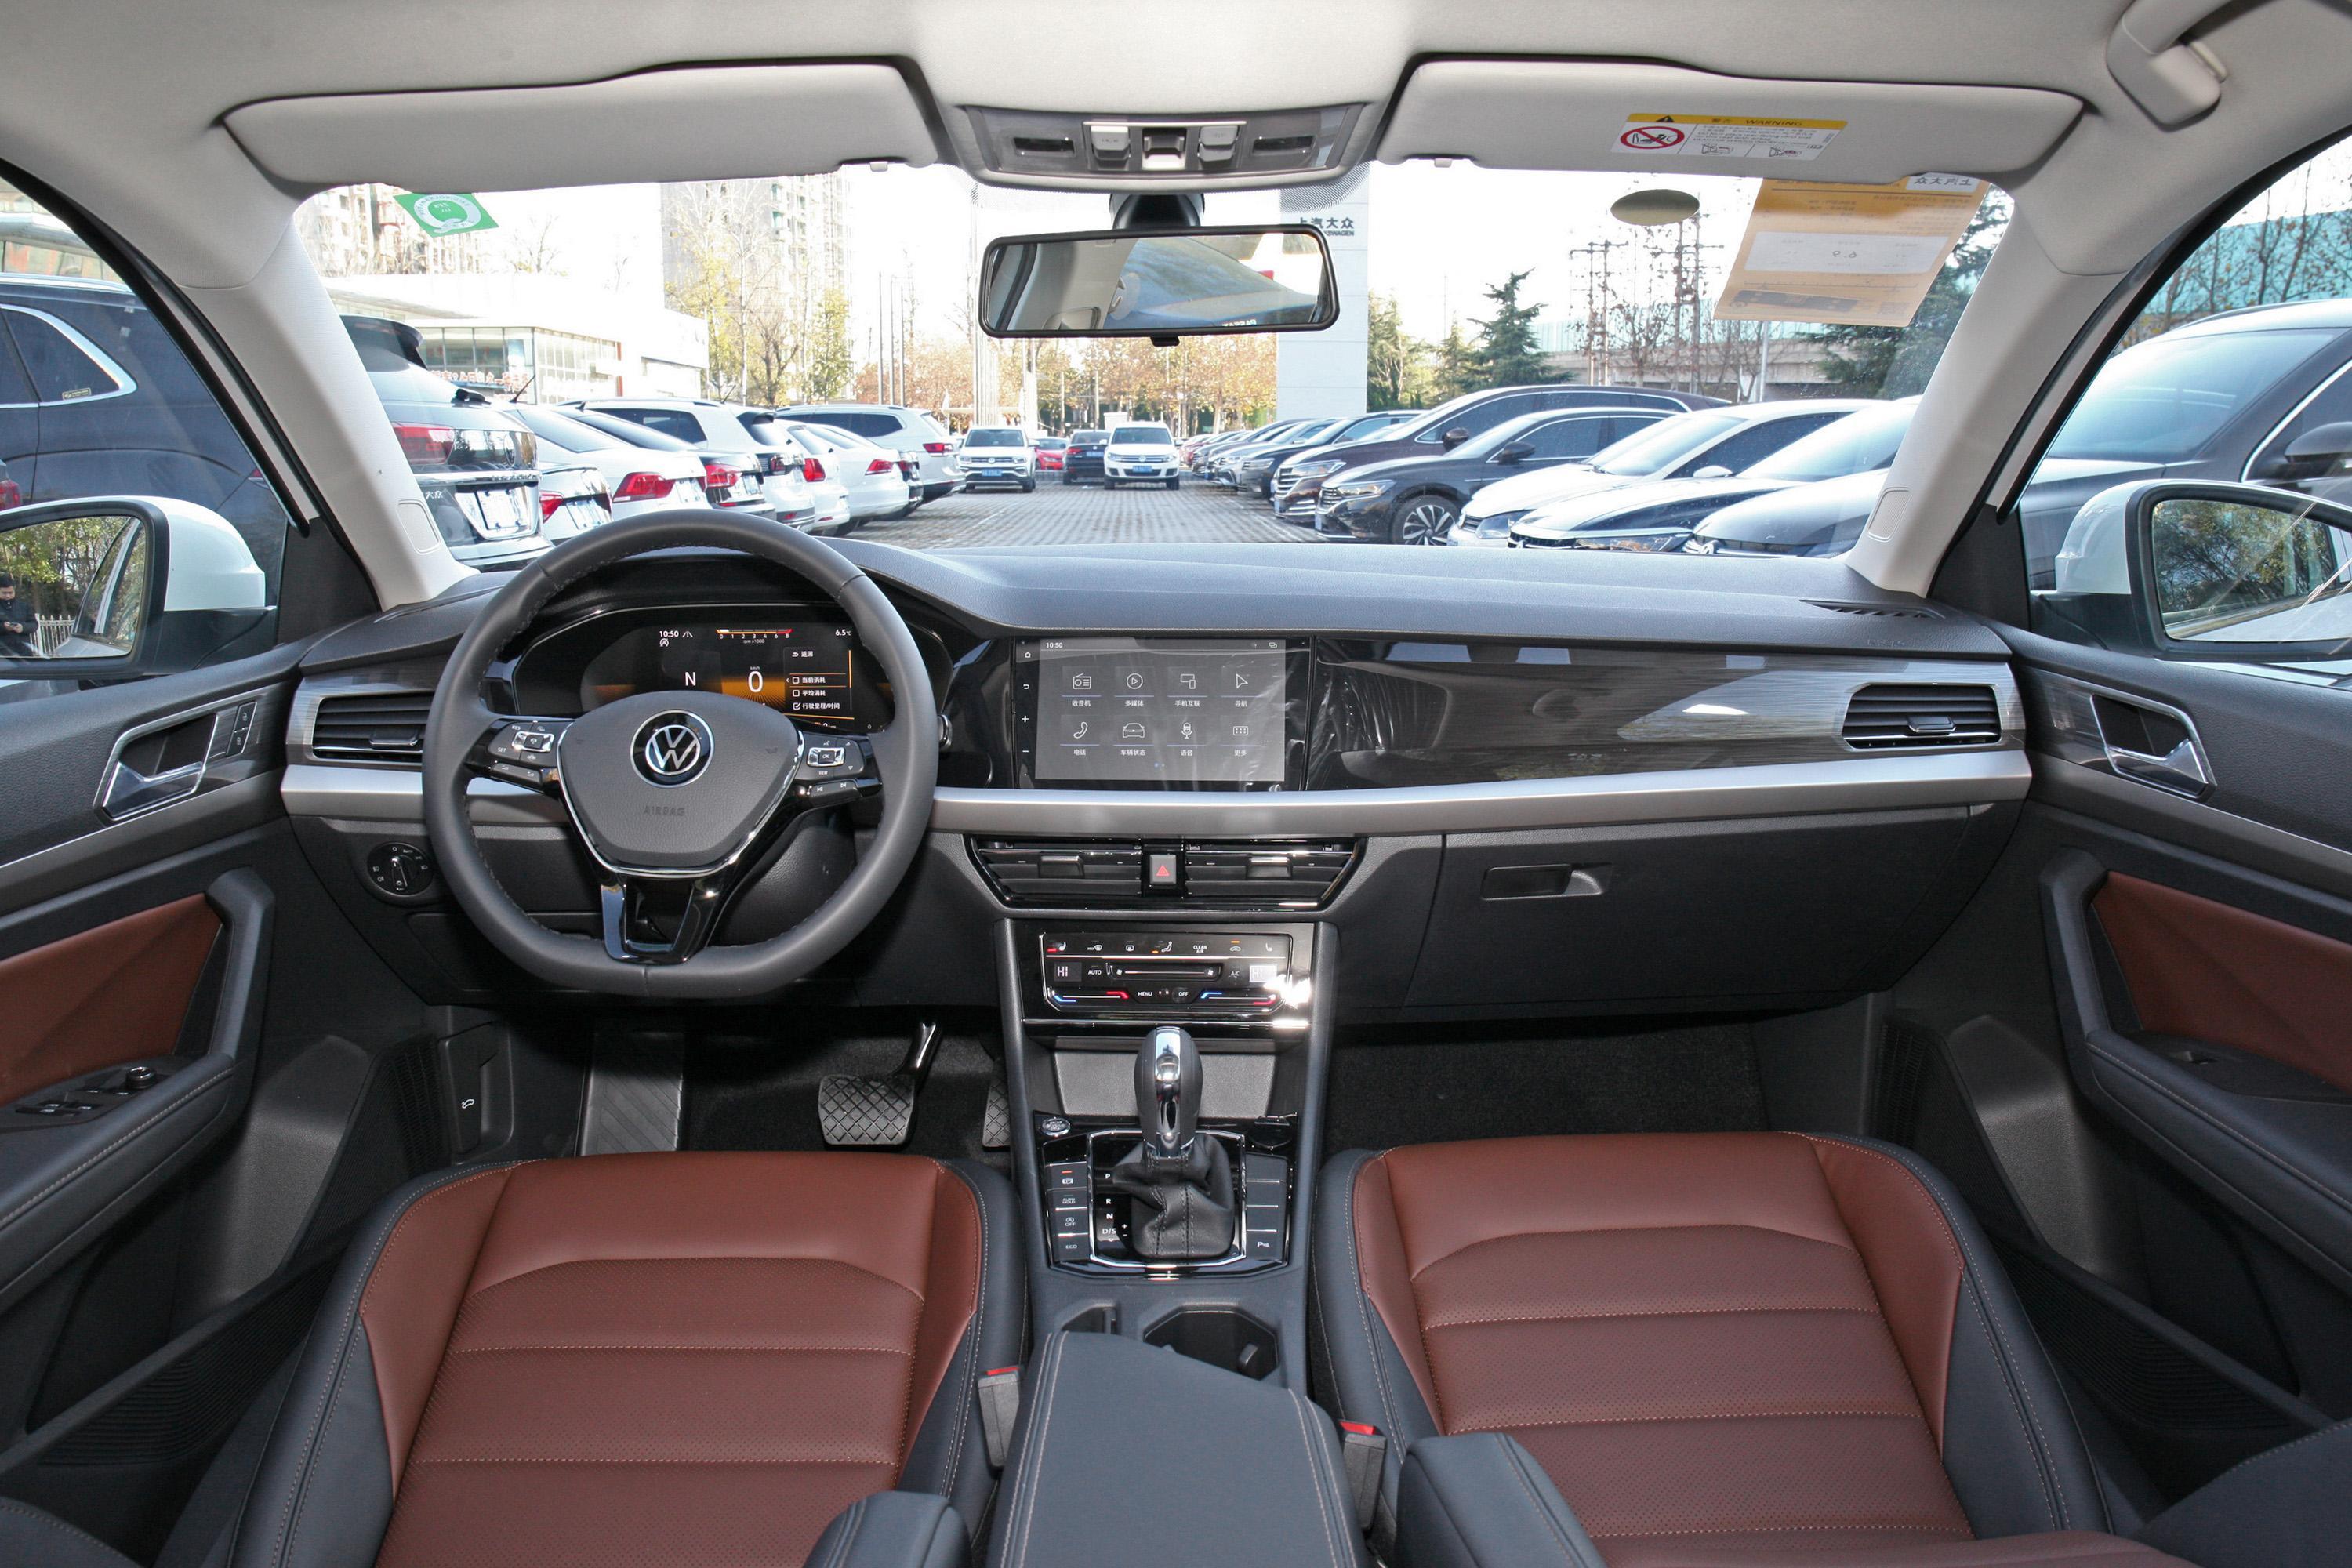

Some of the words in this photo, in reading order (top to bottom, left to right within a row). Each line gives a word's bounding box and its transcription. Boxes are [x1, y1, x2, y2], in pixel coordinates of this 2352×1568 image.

[684, 671, 696, 686] N
[748, 670, 764, 693] 0
[643, 805, 685, 816] AIRBAG
[1057, 966, 1069, 977] HI
